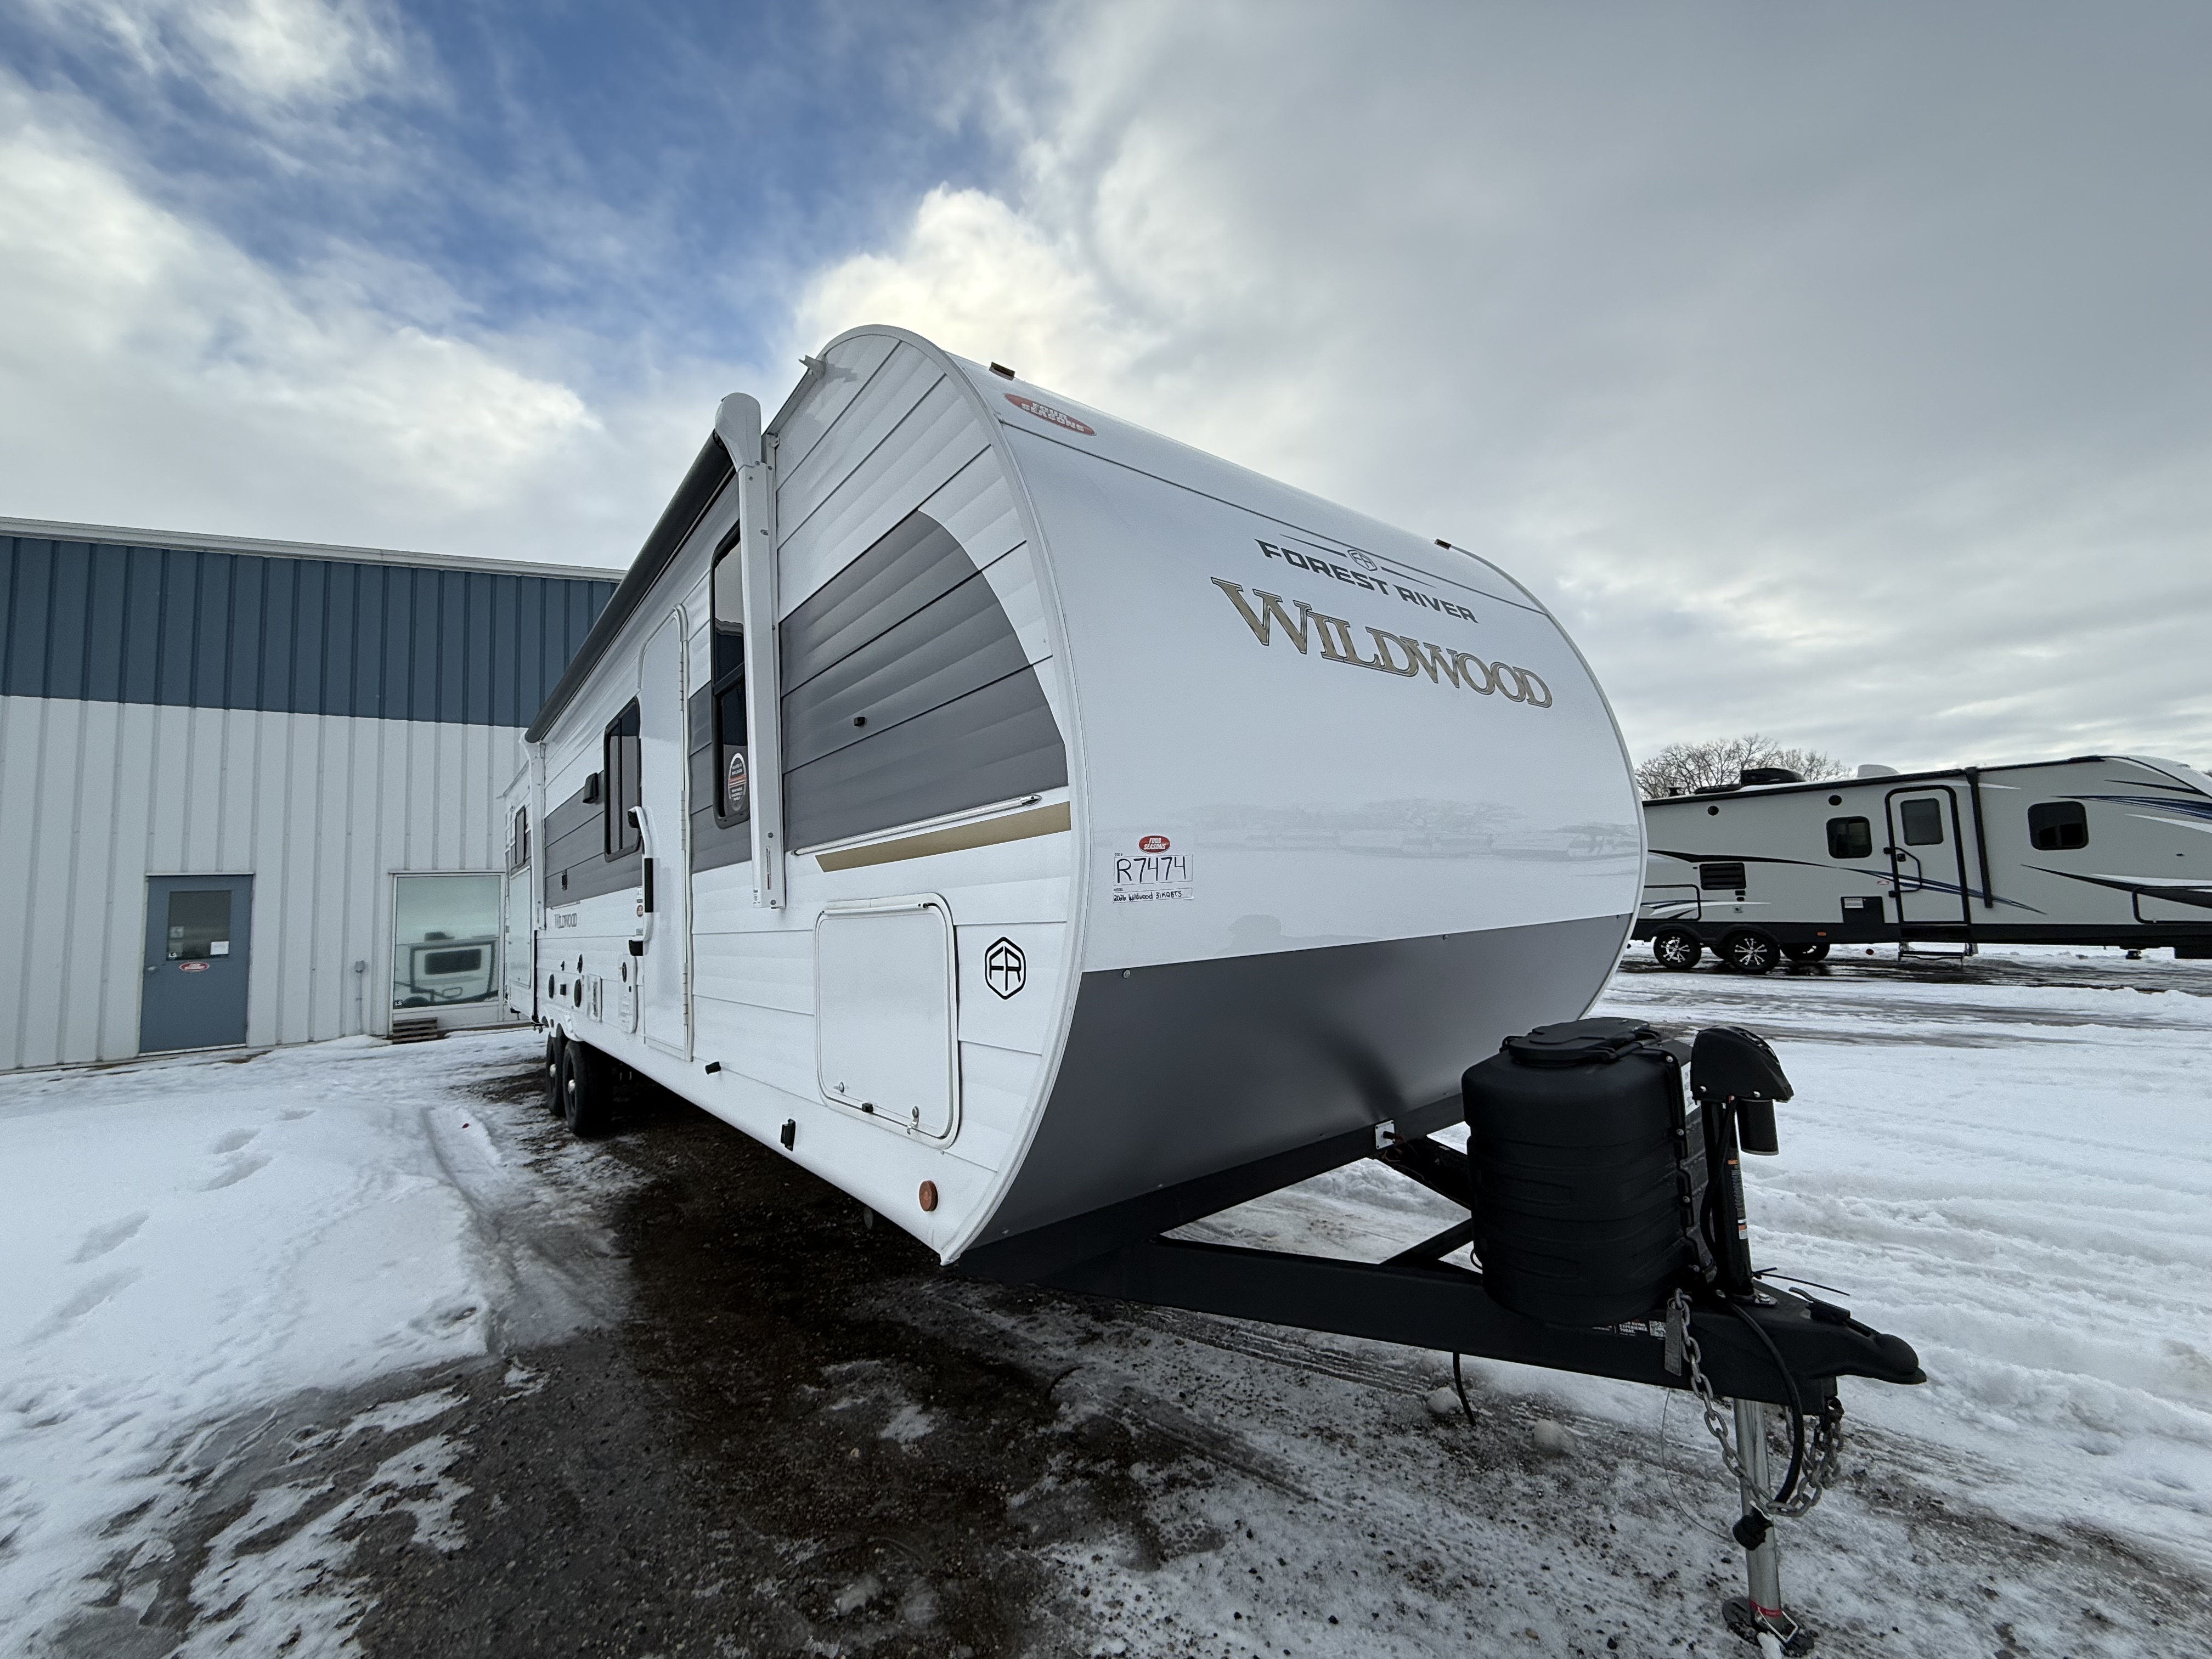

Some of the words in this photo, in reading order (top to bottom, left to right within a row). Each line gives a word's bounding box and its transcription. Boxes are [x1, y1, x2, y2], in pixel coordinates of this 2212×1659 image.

[1021, 403, 1085, 432] SEASONS
[1032, 402, 1068, 420] FOUR
[1254, 538, 1389, 595] FOREST
[1393, 584, 1480, 624] RIVER
[1210, 577, 1553, 709] WILDWOOD
[1116, 856, 1187, 884] R7474
[1128, 891, 1153, 901] Wildwood
[554, 912, 578, 929] WILDWOOD
